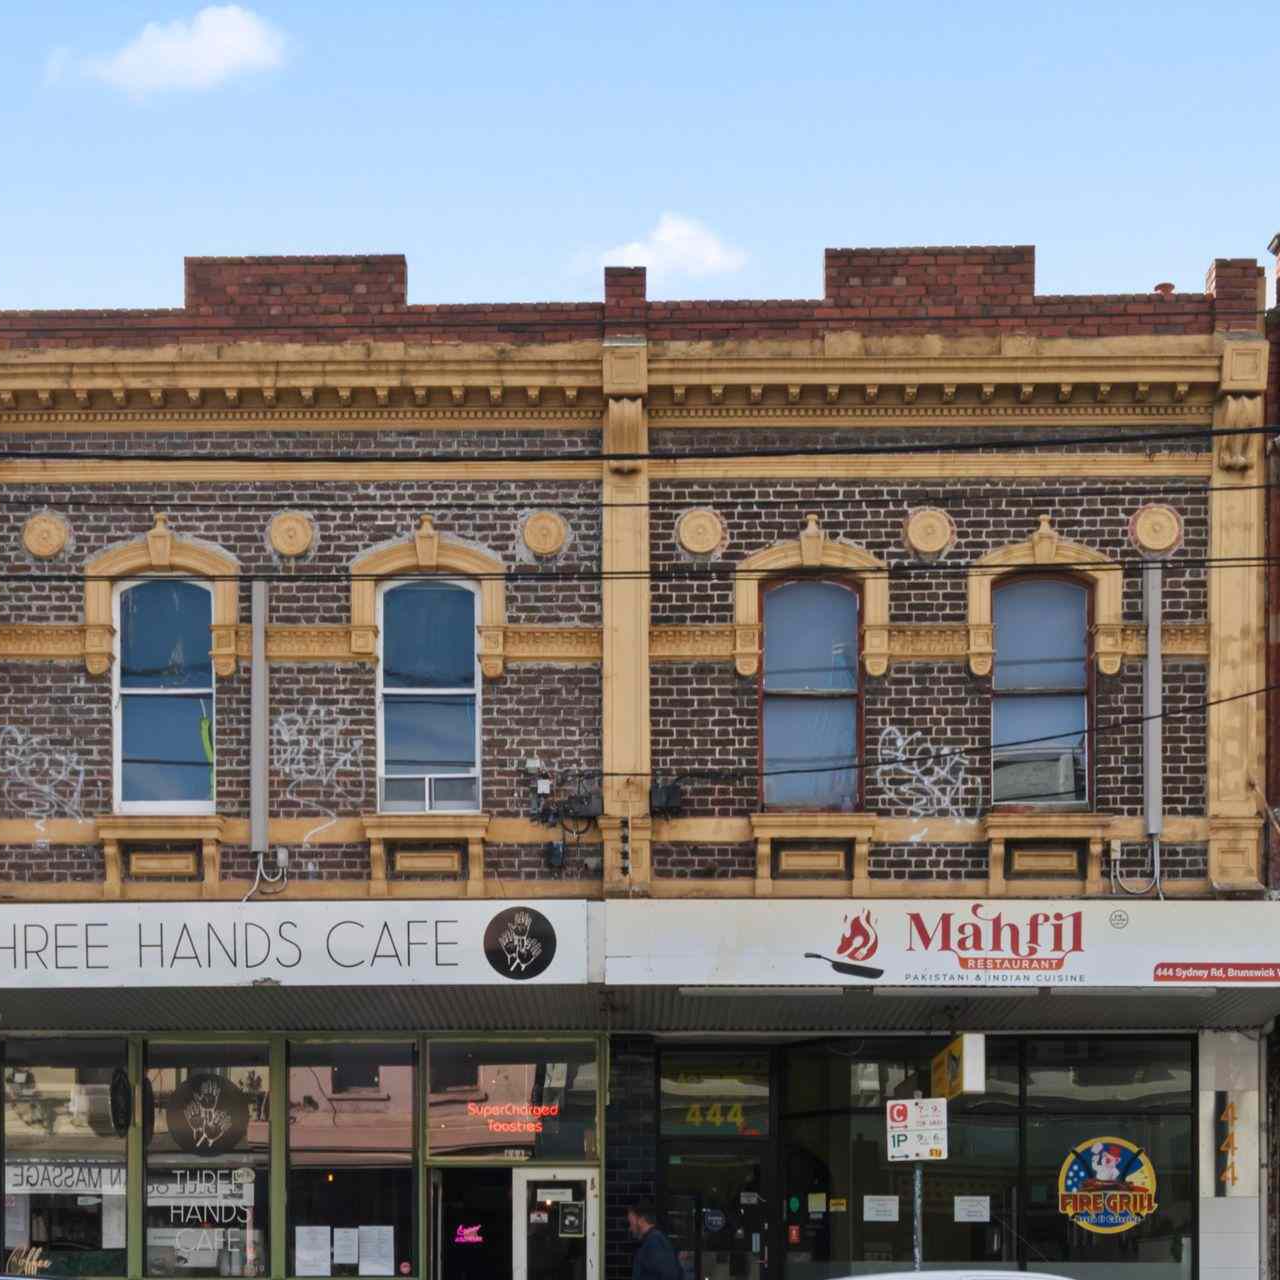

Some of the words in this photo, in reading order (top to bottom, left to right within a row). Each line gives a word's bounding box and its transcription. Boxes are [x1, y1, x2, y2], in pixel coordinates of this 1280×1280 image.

[906, 903, 1085, 957] Mahfil
[138, 920, 303, 969] HANDS
[326, 919, 459, 968] CAFE
[967, 959, 1059, 969] RESTAURANT
[1156, 967, 1174, 977] 444
[1175, 967, 1208, 979] Sydney
[1210, 967, 1226, 979] Rd,
[1227, 967, 1274, 977] Brunswick
[904, 974, 970, 982] PAKISTANI
[974, 974, 982, 982] &
[987, 974, 1031, 982] INDIAN
[1035, 974, 1086, 983] CUISINE
[172, 1169, 241, 1194] THREE
[170, 1200, 250, 1223] HANDS
[1059, 1190, 1104, 1213] FIRE
[1105, 1190, 1156, 1214] GRILL
[176, 1228, 240, 1252] CAFE
